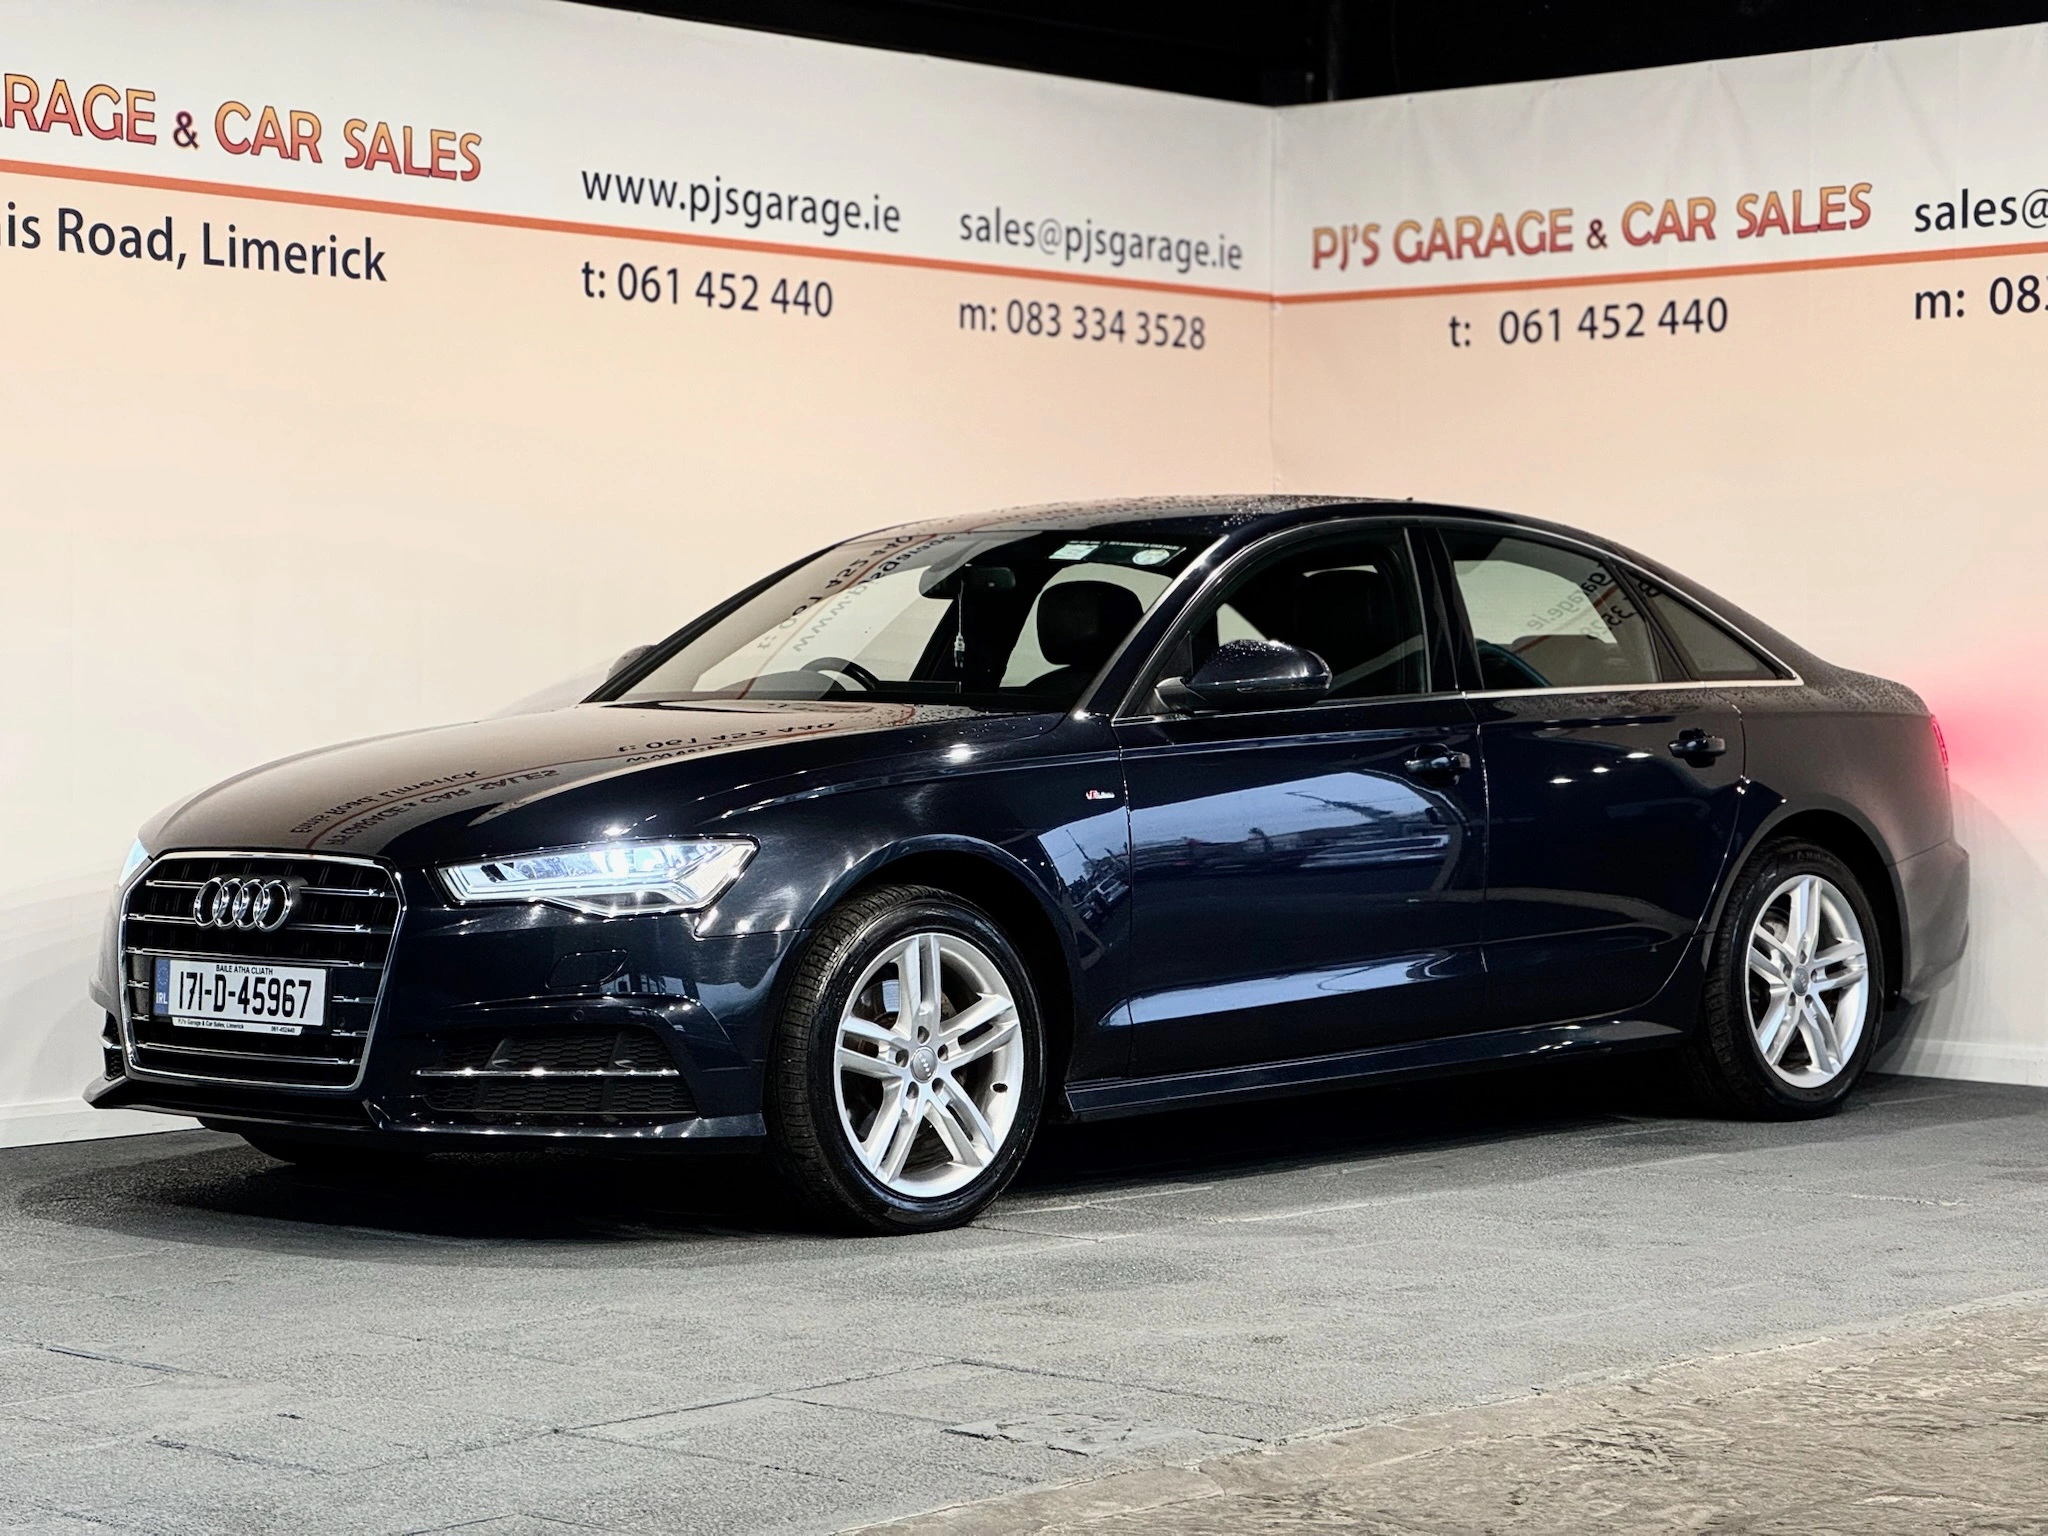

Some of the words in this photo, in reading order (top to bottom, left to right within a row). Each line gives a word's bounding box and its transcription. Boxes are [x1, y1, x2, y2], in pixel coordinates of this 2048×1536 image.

[0, 73, 157, 145] RAGE
[173, 111, 199, 150] &
[215, 101, 323, 164] CAR
[344, 118, 482, 182] SALES
[582, 171, 900, 237] www.pjsgarage.ie
[1313, 224, 1380, 271] PJ'S
[1393, 208, 1573, 264] GARAGE
[1587, 219, 1607, 249] &
[1622, 197, 1716, 246] CAR
[1736, 183, 1872, 239] SALES
[0, 202, 41, 249] is
[59, 208, 186, 270] Road,
[203, 222, 387, 281] Limerick
[960, 207, 1242, 273] sales@pjsgarage.ie
[582, 261, 605, 298] t:
[618, 263, 677, 304] 061
[695, 271, 758, 311] 452
[771, 278, 832, 317] 440
[1916, 290, 1964, 320] m:
[1990, 275, 2048, 315] 08
[960, 304, 996, 331] m:
[1007, 300, 1061, 337] 083
[1073, 306, 1125, 342] 334
[1137, 312, 1205, 350] 3528
[1449, 317, 1470, 347] t:
[1500, 308, 1559, 344] 061
[1578, 303, 1644, 339] 452
[1658, 297, 1728, 335] 440
[179, 970, 312, 1019] 171-D-45967
[216, 964, 232, 973] BAILE
[252, 967, 274, 976] CLIATH
[156, 992, 168, 1004] IRL
